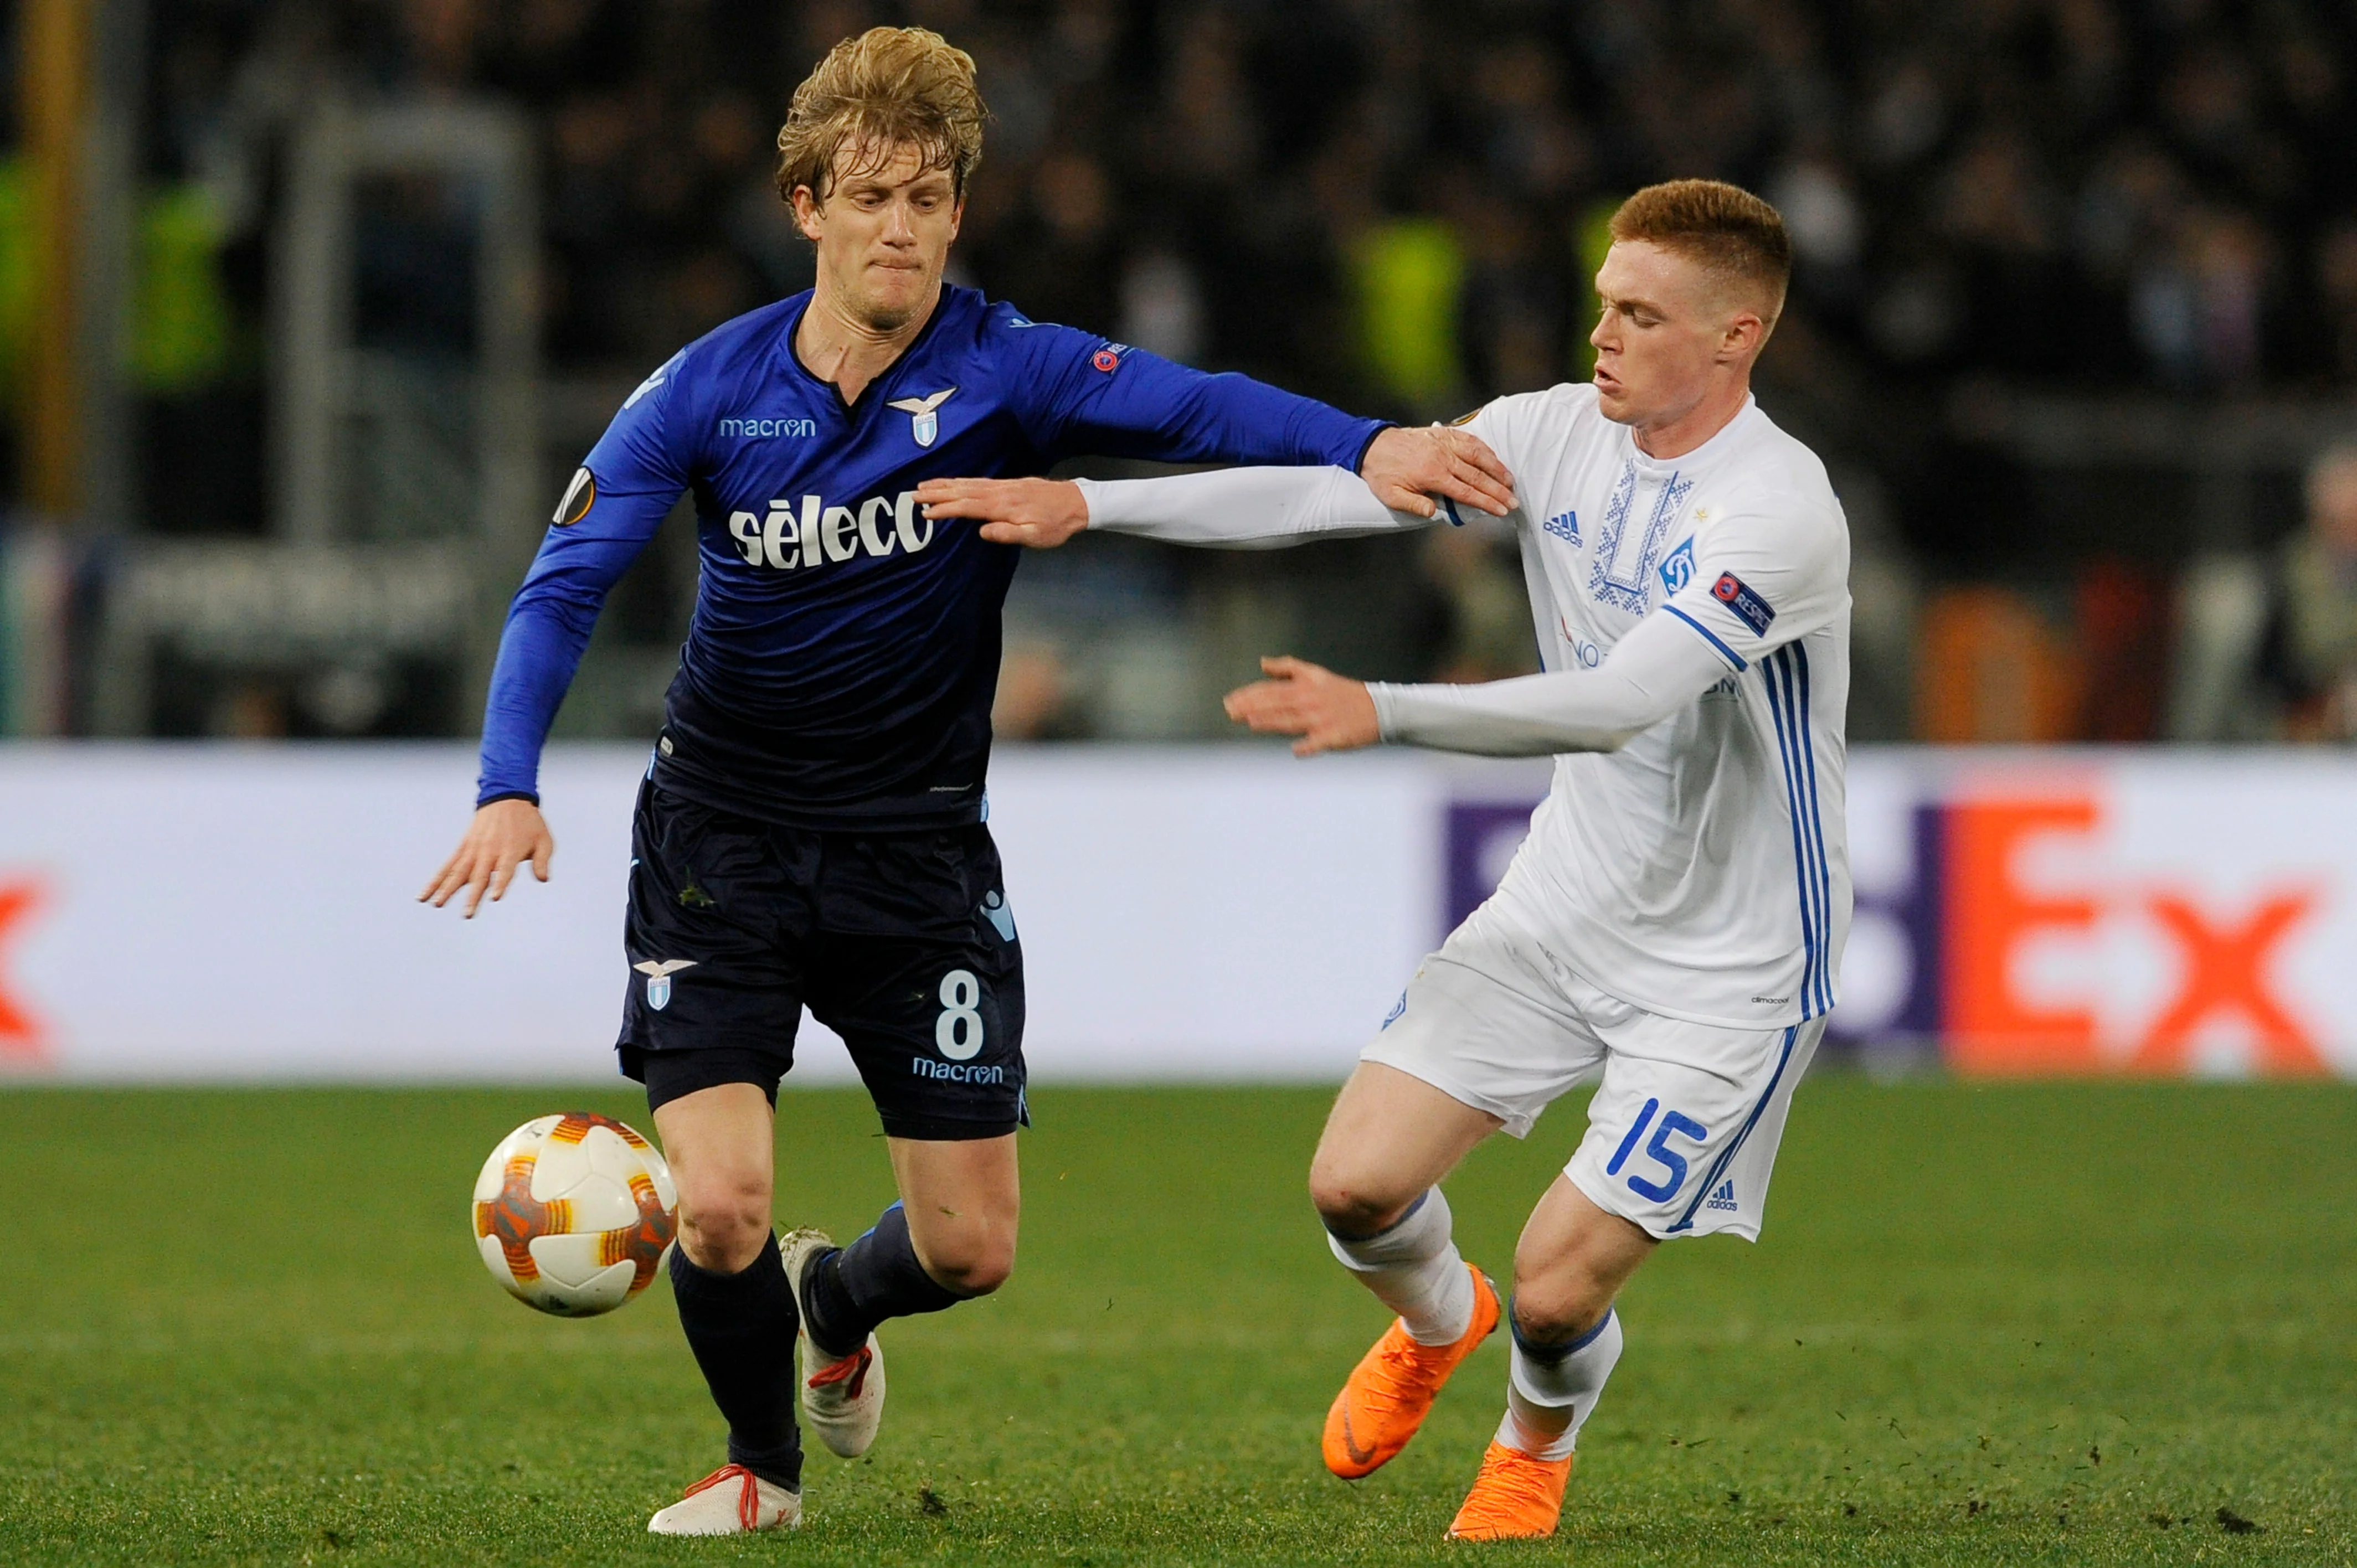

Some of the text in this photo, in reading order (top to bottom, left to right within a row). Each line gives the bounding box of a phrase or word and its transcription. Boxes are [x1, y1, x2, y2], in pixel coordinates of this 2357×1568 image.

[721, 419, 816, 437] macron
[1543, 522, 1583, 548] adidas
[936, 969, 984, 1060] 8
[913, 1057, 1003, 1084] macron
[1607, 1098, 1707, 1203] 15
[1707, 1199, 1737, 1211] adidas
